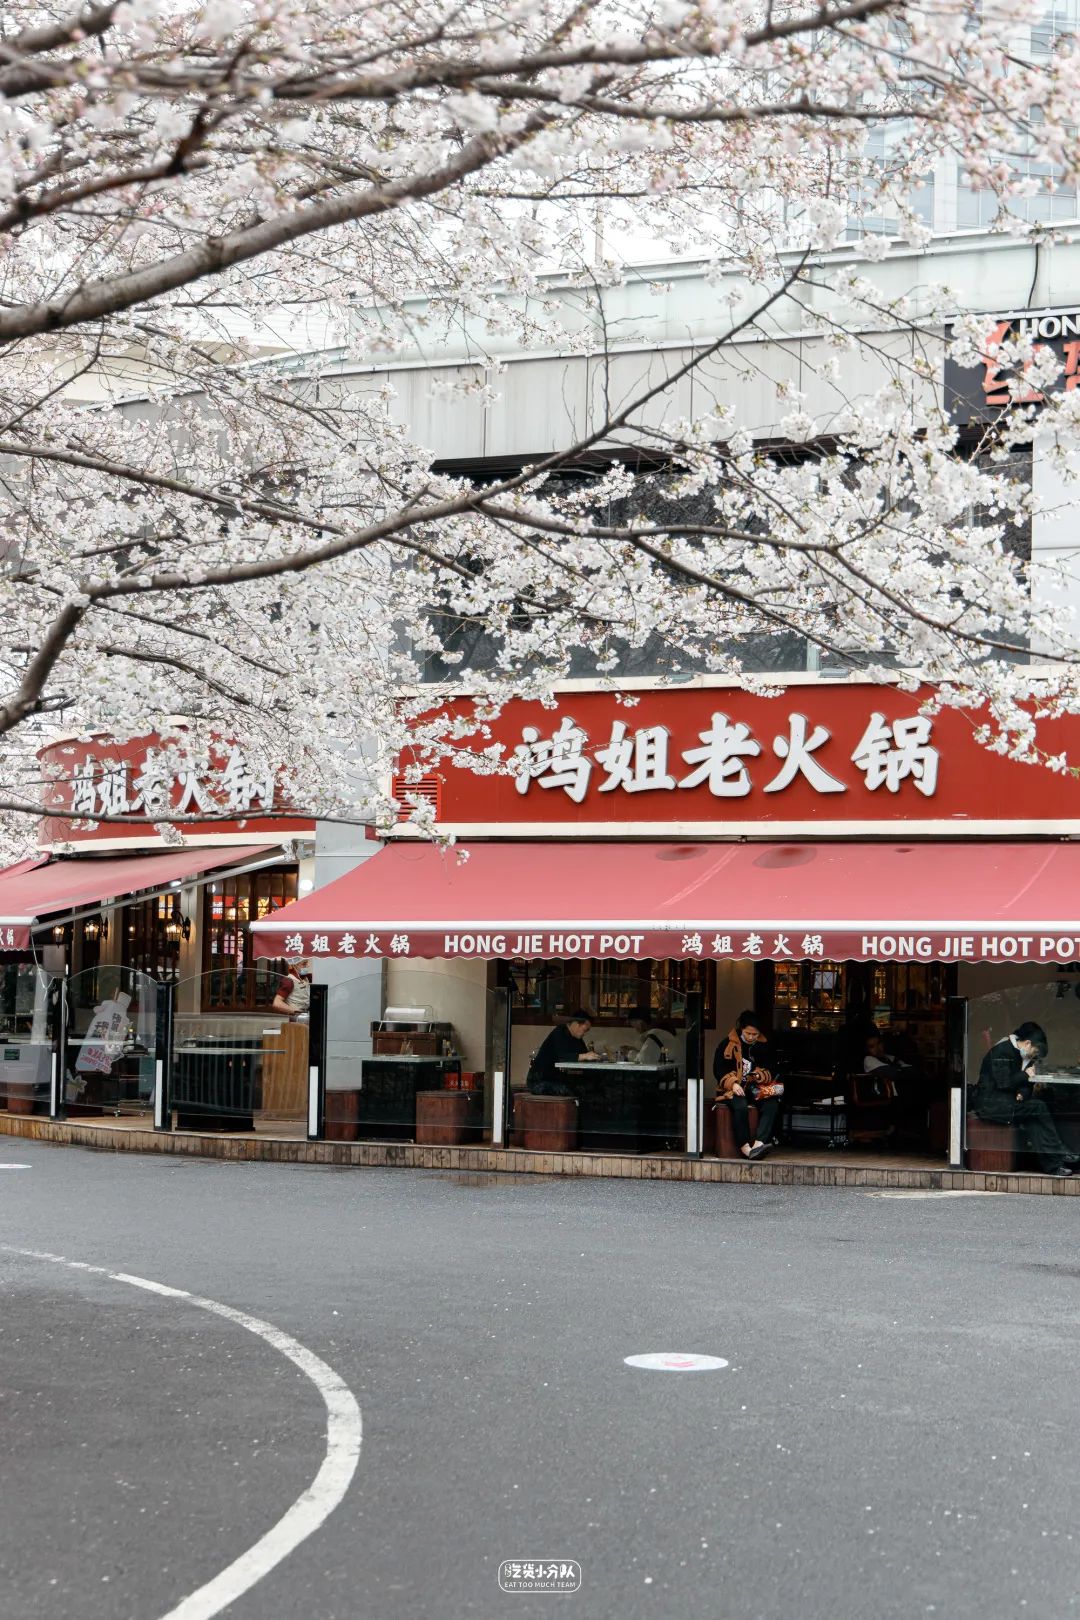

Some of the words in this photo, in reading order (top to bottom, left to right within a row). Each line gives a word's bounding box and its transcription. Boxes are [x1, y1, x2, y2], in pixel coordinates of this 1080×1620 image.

[513, 711, 940, 803] 鸿姐老火锅
[285, 932, 410, 955] 鸿姐老火锅
[444, 934, 506, 954] HONG
[511, 934, 543, 954] JIE
[549, 934, 595, 954] HOT
[600, 934, 645, 954] POT
[681, 932, 825, 956] 鸿姐老火锅
[861, 935, 932, 957] HONG
[938, 936, 975, 957] JIE
[981, 936, 1033, 957] HOT
